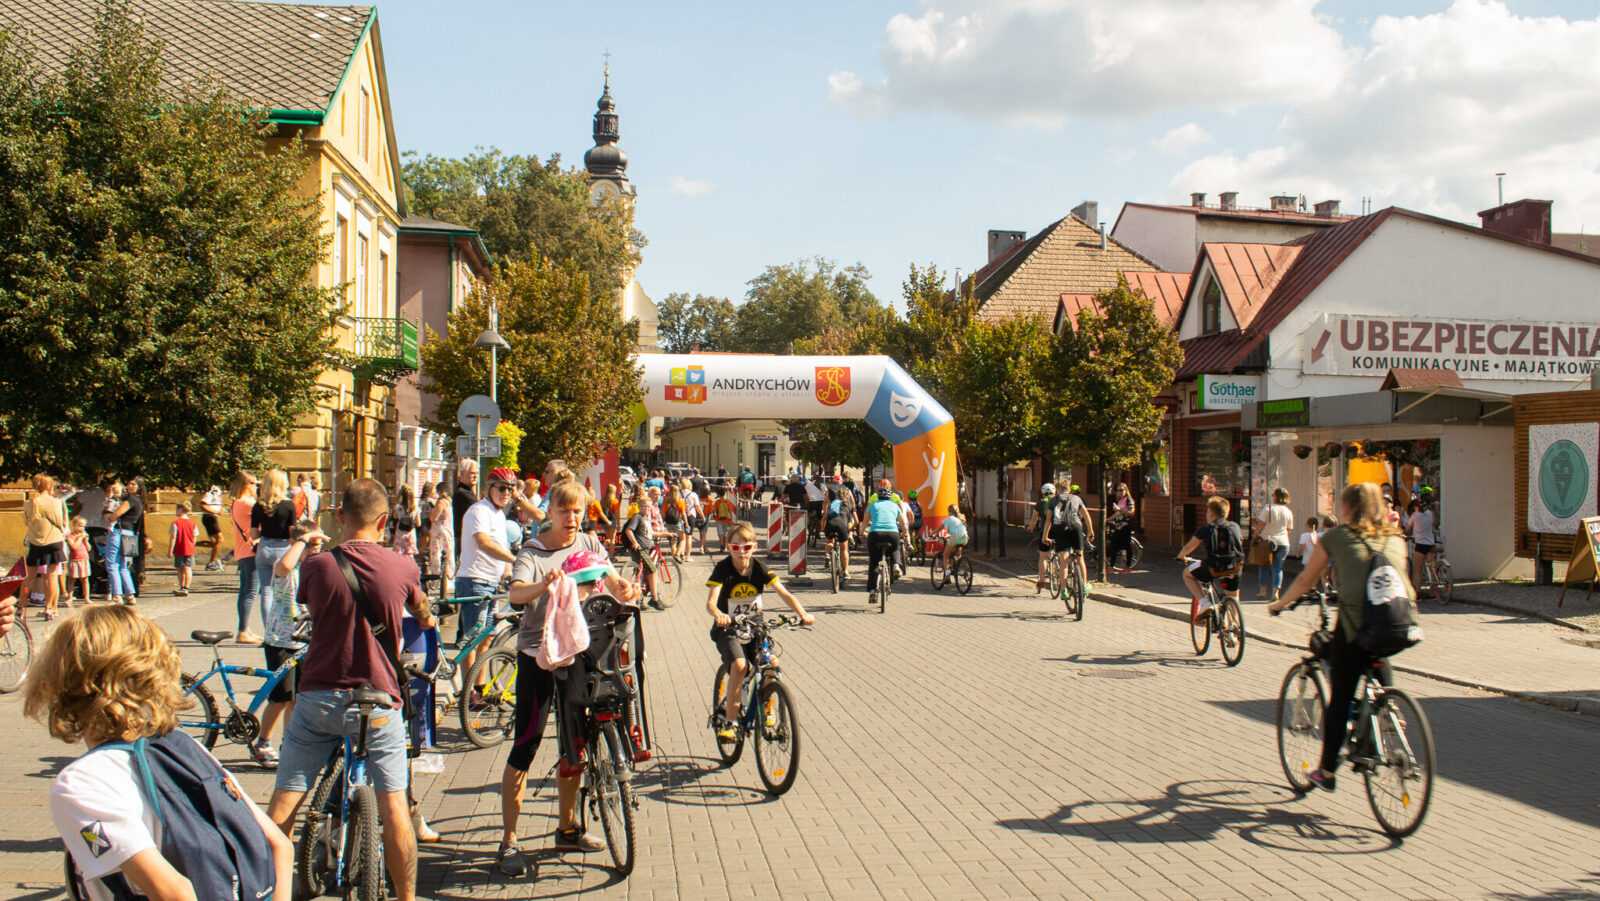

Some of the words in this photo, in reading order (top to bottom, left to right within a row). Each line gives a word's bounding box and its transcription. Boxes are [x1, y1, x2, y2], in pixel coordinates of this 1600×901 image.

[1340, 319, 1600, 358] UBEZPIECZENIA
[1352, 356, 1489, 372] KOMUNIKACYJNE
[712, 376, 810, 391] ANDRYCHÓW
[1209, 382, 1256, 398] Gothaer
[733, 602, 759, 615] 424
